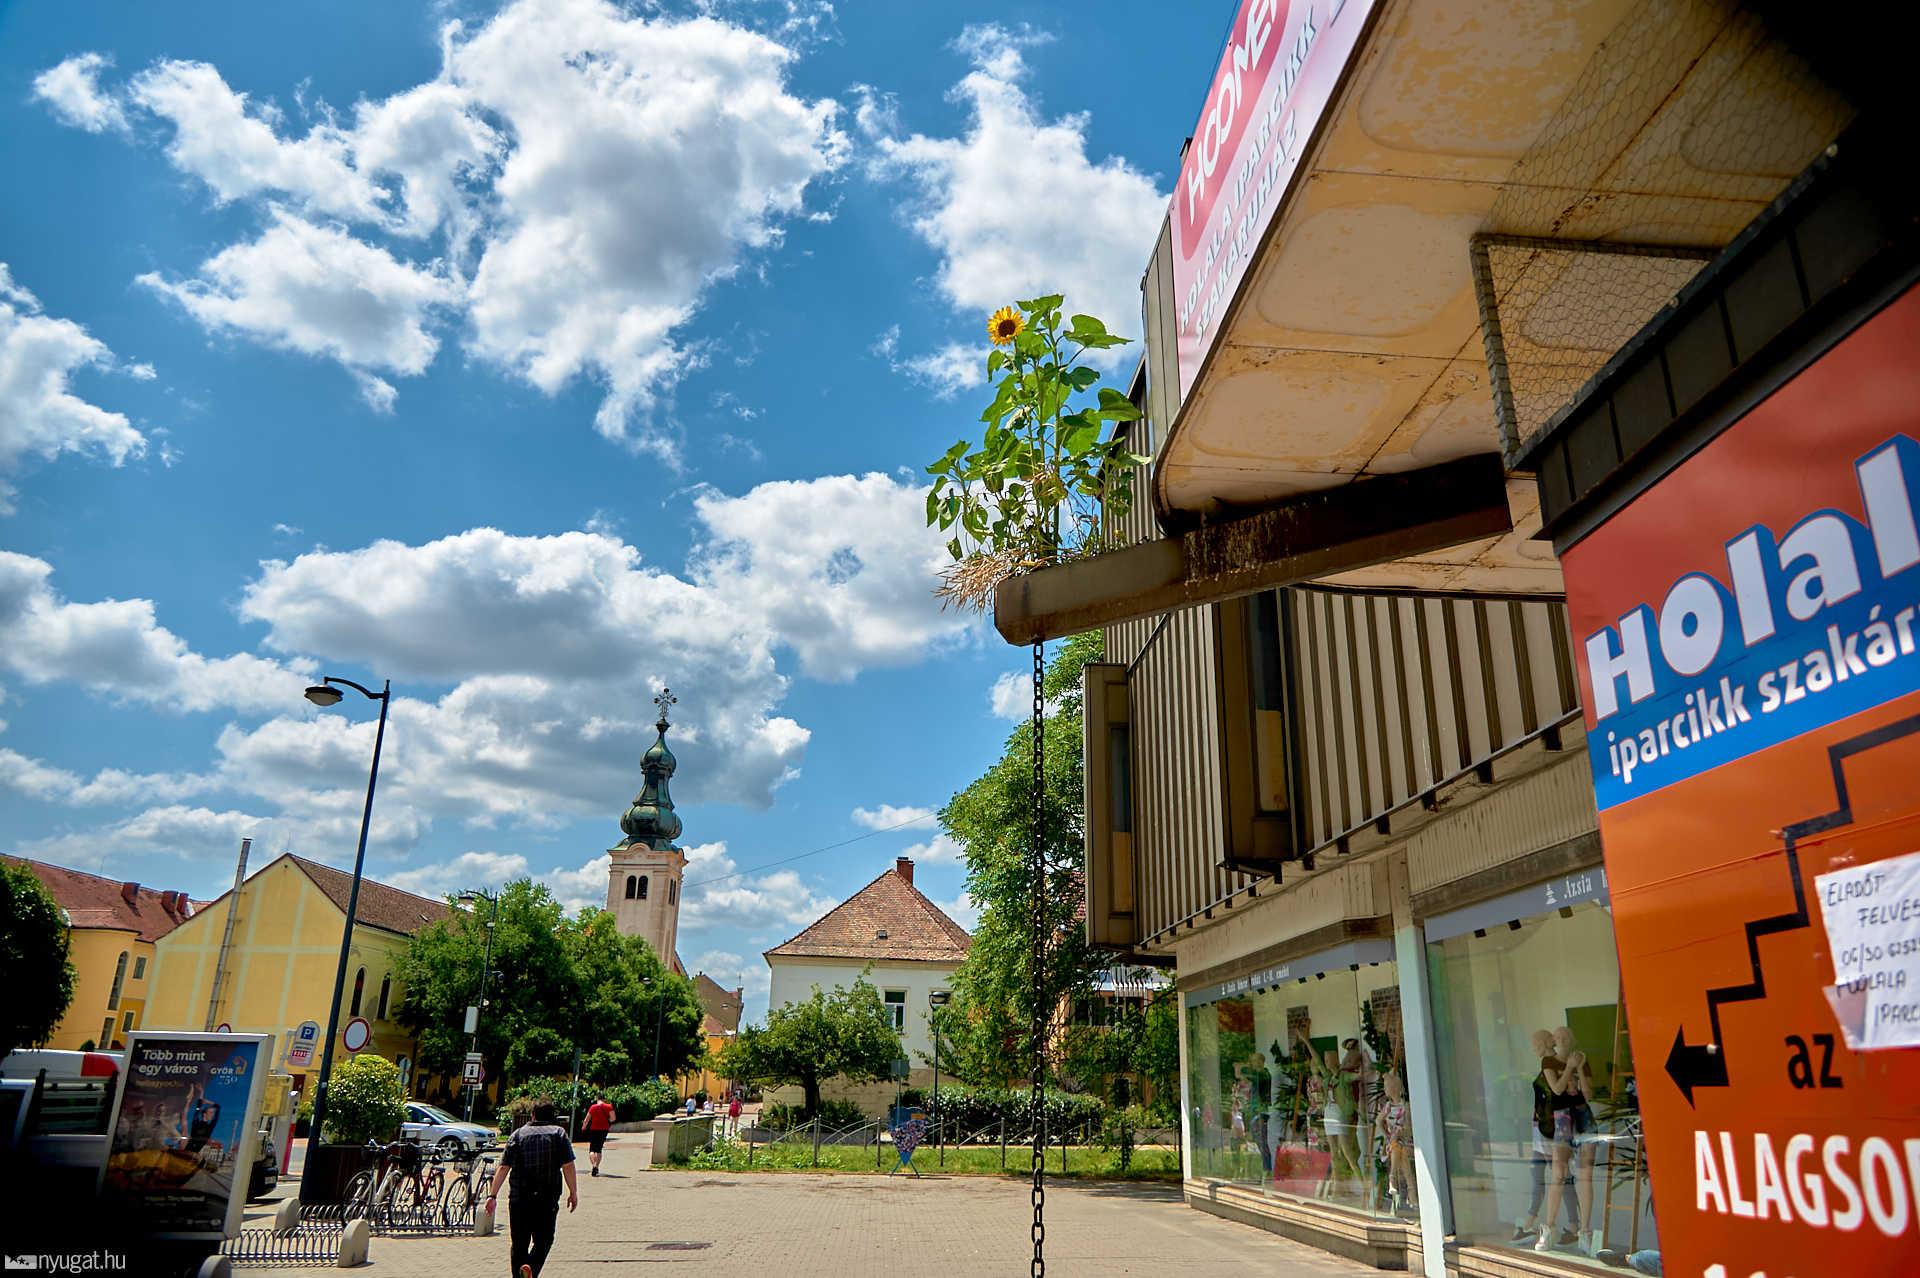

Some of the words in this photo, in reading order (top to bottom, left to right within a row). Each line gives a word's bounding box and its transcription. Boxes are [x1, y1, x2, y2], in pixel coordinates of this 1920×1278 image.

[1181, 204, 1232, 336] HOLALA
[1234, 5, 1317, 210] IPARCIKK
[1196, 108, 1297, 345] SZAKÁRUHÁZ
[1608, 676, 1752, 784] iparcikk
[1758, 604, 1920, 713] szakár
[138, 1064, 162, 1076] egy
[164, 1063, 199, 1074] város
[143, 1049, 174, 1061] Több
[176, 1051, 206, 1061] mint
[1785, 1034, 1844, 1090] az
